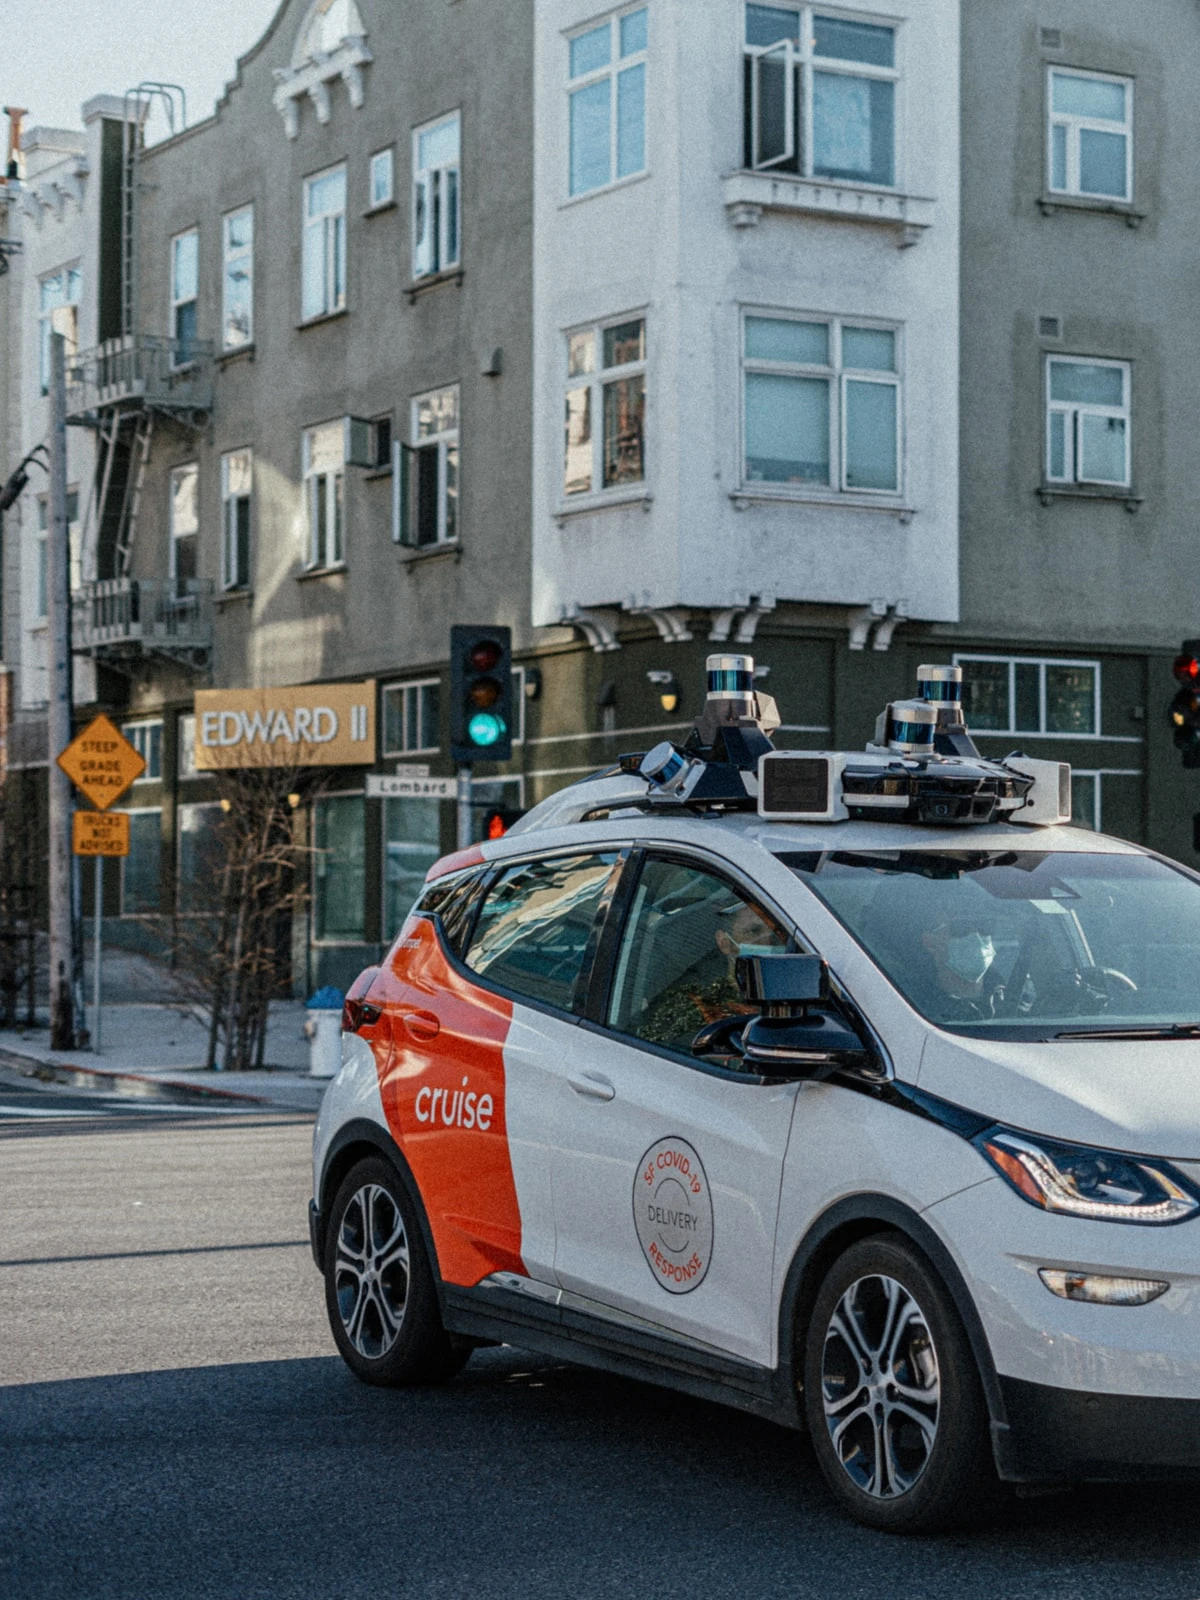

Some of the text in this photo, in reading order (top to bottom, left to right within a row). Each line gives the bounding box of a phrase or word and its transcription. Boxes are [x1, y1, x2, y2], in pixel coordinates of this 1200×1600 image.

[202, 704, 367, 747] EDWARD II
[81, 740, 118, 752] STEEP
[80, 760, 120, 772] GRADE
[83, 774, 123, 787] AHEAD
[380, 781, 447, 794] Lombard
[82, 815, 121, 827] TRUCKS
[93, 828, 111, 838] NOT
[79, 840, 123, 851] ADVISED
[415, 1075, 494, 1131] cruise
[644, 1151, 701, 1194] SF COVID-19
[648, 1205, 698, 1231] DELIVERY
[649, 1241, 702, 1283] RESPONSE
